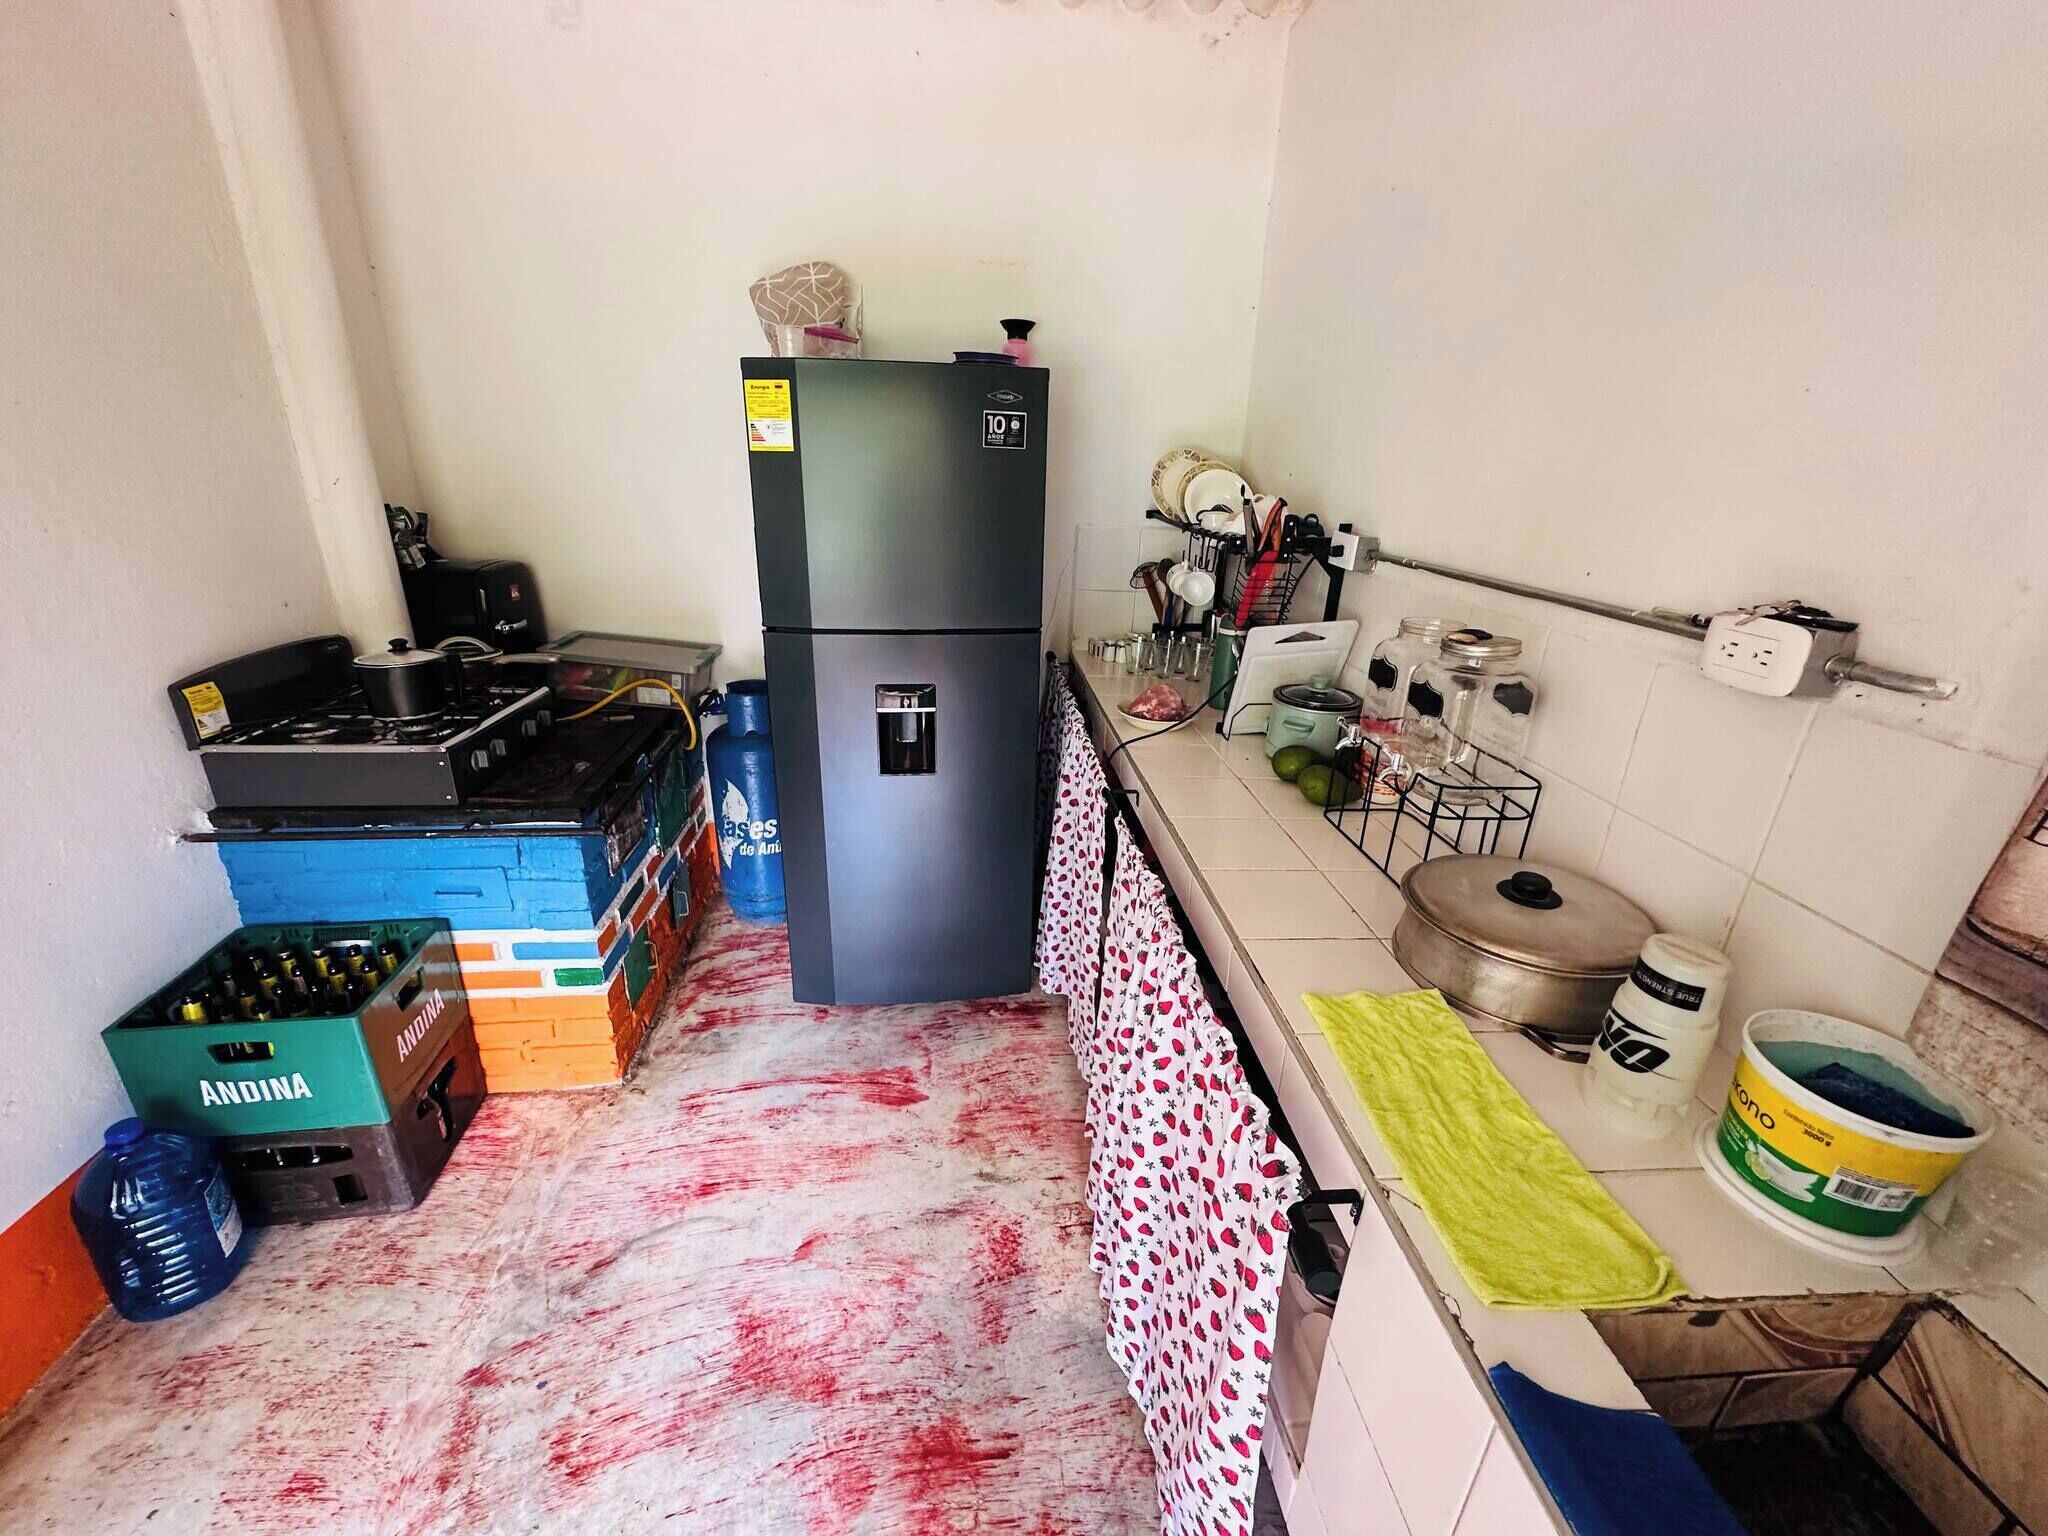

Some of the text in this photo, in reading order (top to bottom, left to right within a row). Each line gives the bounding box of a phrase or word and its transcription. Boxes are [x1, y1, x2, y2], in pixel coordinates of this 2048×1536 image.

[987, 415, 1006, 434] 10
[723, 818, 778, 840] ases
[739, 842, 755, 856] de
[1676, 991, 1701, 1004] TRUE
[396, 988, 445, 1063] ANDINA
[200, 1072, 313, 1107] ANDINA
[1731, 1072, 1775, 1130] kono
